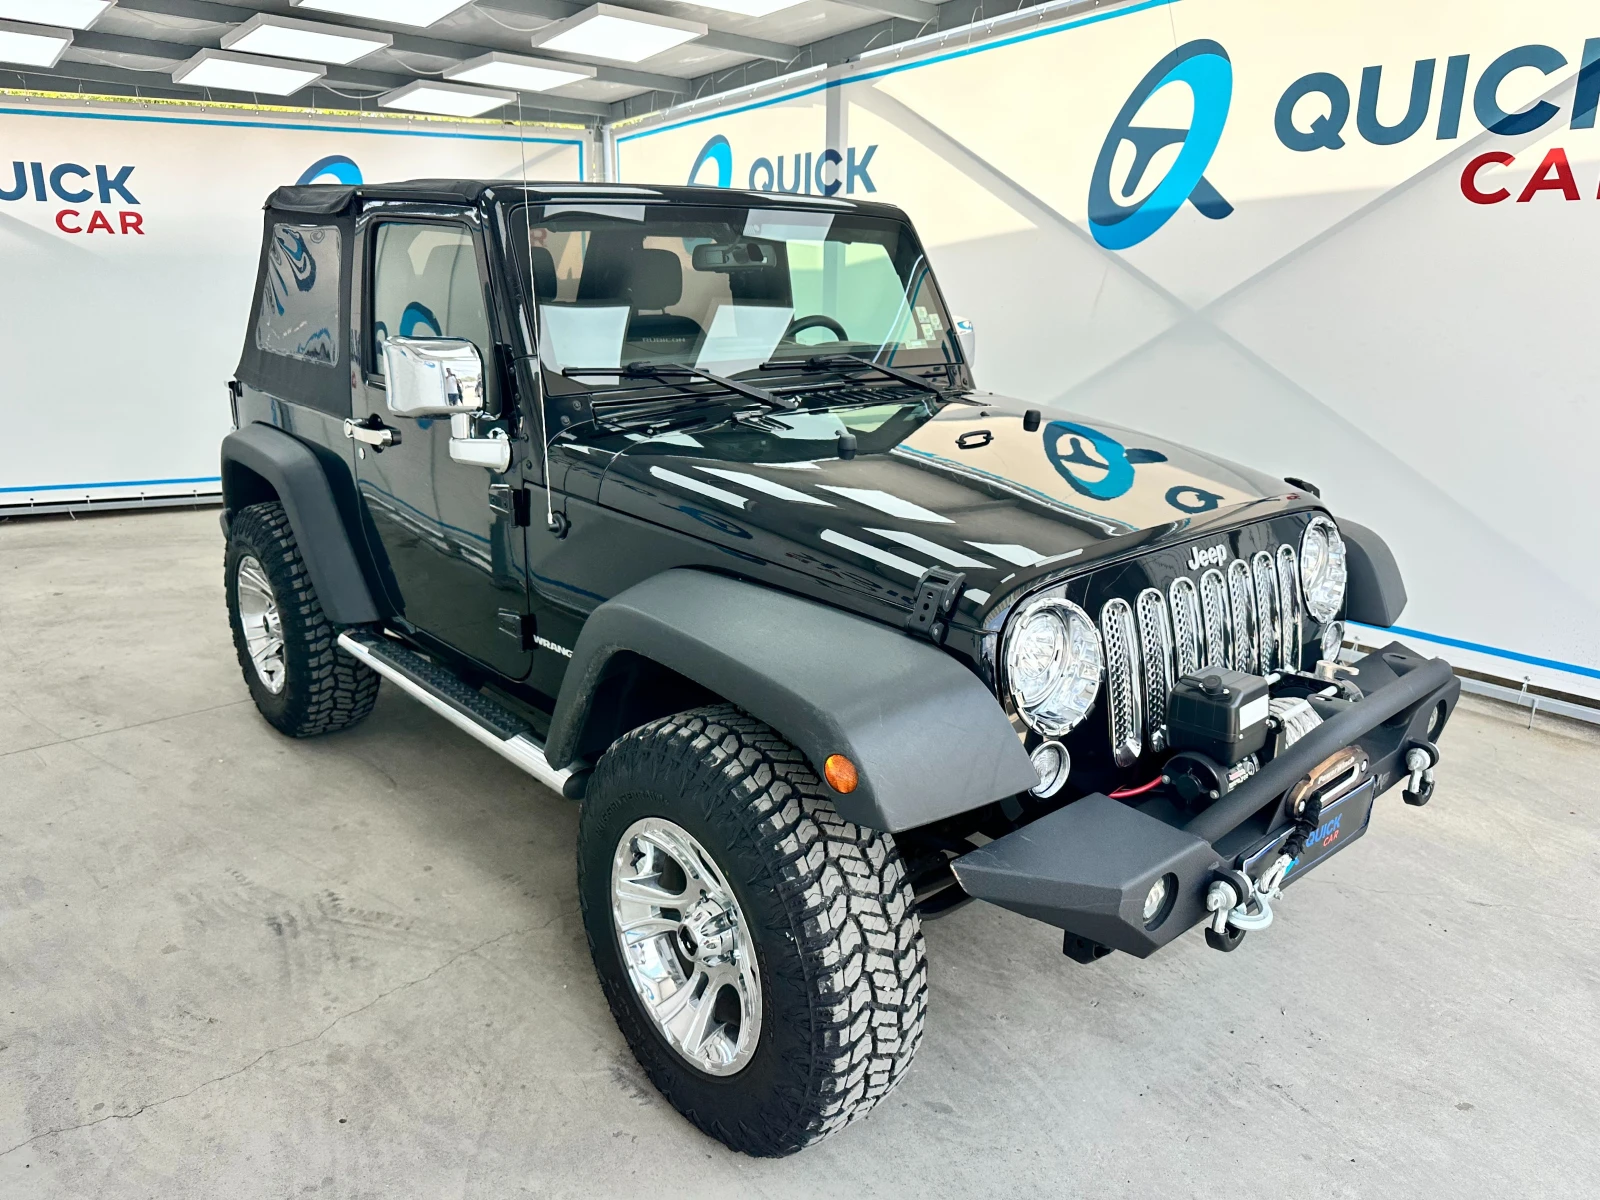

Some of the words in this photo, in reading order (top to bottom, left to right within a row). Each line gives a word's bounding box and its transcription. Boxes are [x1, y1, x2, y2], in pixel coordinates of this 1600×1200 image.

[749, 145, 878, 196] QUICK
[1460, 147, 1600, 205] CA
[55, 209, 145, 235] CAR
[1187, 544, 1227, 570] Jeep
[1306, 814, 1342, 847] QUICK
[1324, 830, 1339, 846] CAR
